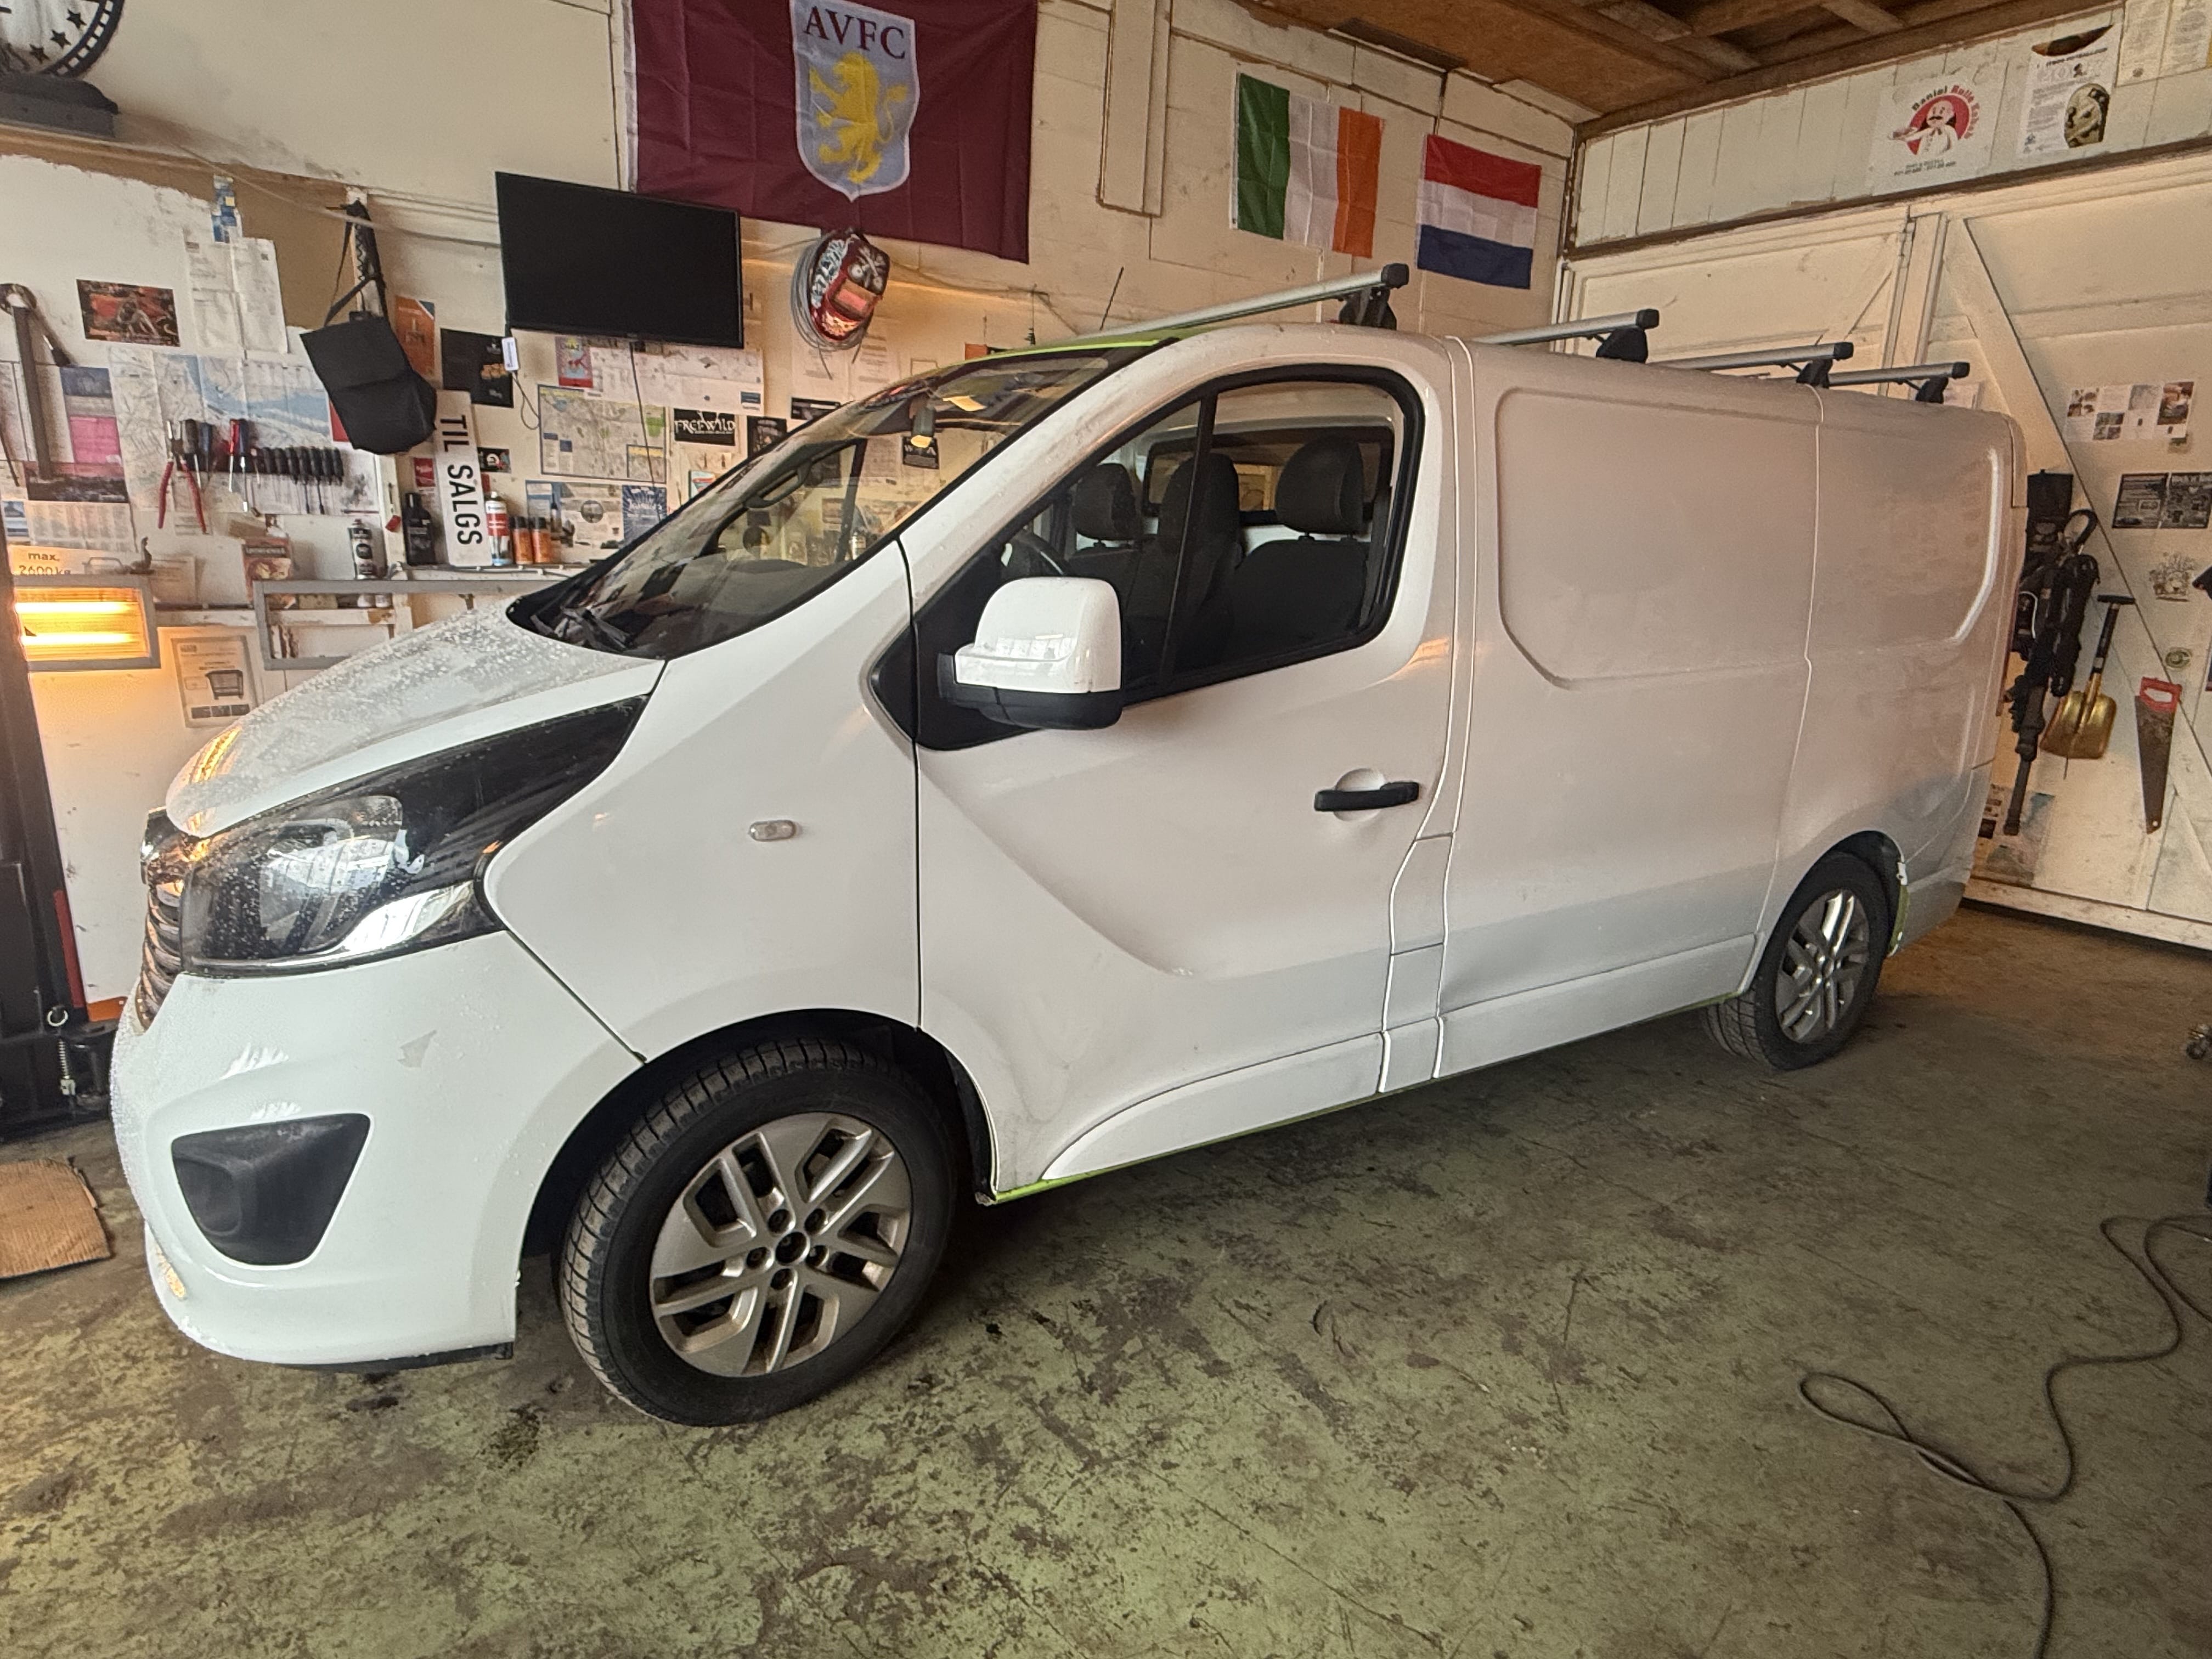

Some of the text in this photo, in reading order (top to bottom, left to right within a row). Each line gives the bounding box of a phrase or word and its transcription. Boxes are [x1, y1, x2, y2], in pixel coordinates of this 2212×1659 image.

[803, 5, 906, 59] AVFC
[440, 415, 483, 544] TIL SALGS
[28, 552, 60, 561] max.
